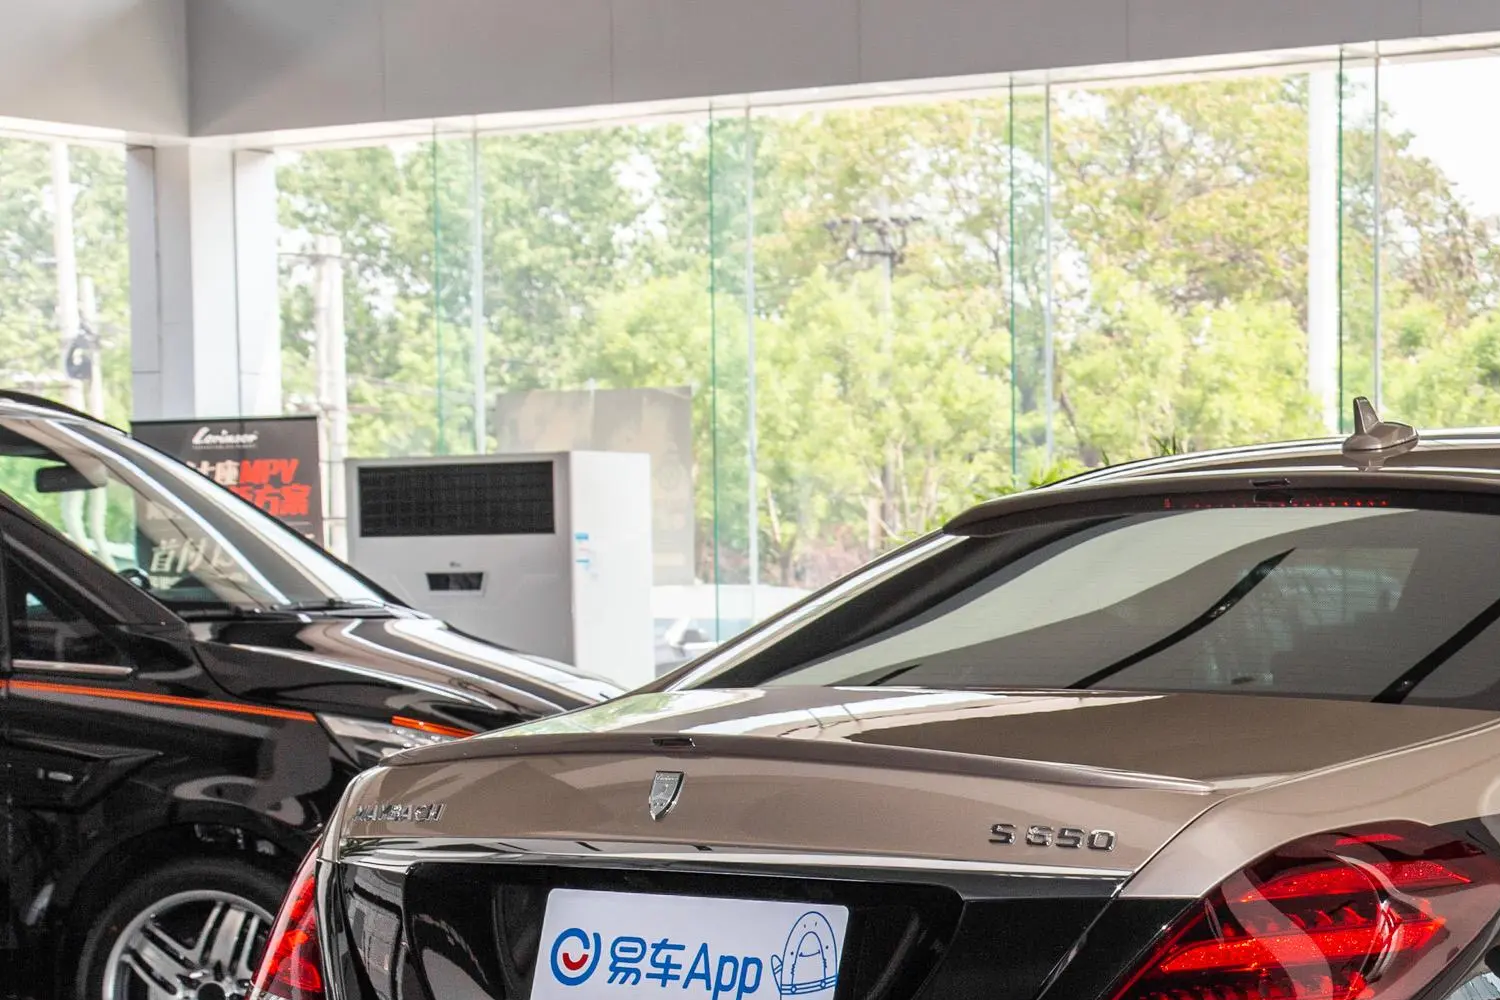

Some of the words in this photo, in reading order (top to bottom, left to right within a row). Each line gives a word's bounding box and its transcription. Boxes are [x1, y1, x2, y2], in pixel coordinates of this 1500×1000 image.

[352, 803, 447, 823] MAYBACH
[988, 823, 1016, 844] S
[1025, 825, 1118, 851] 650
